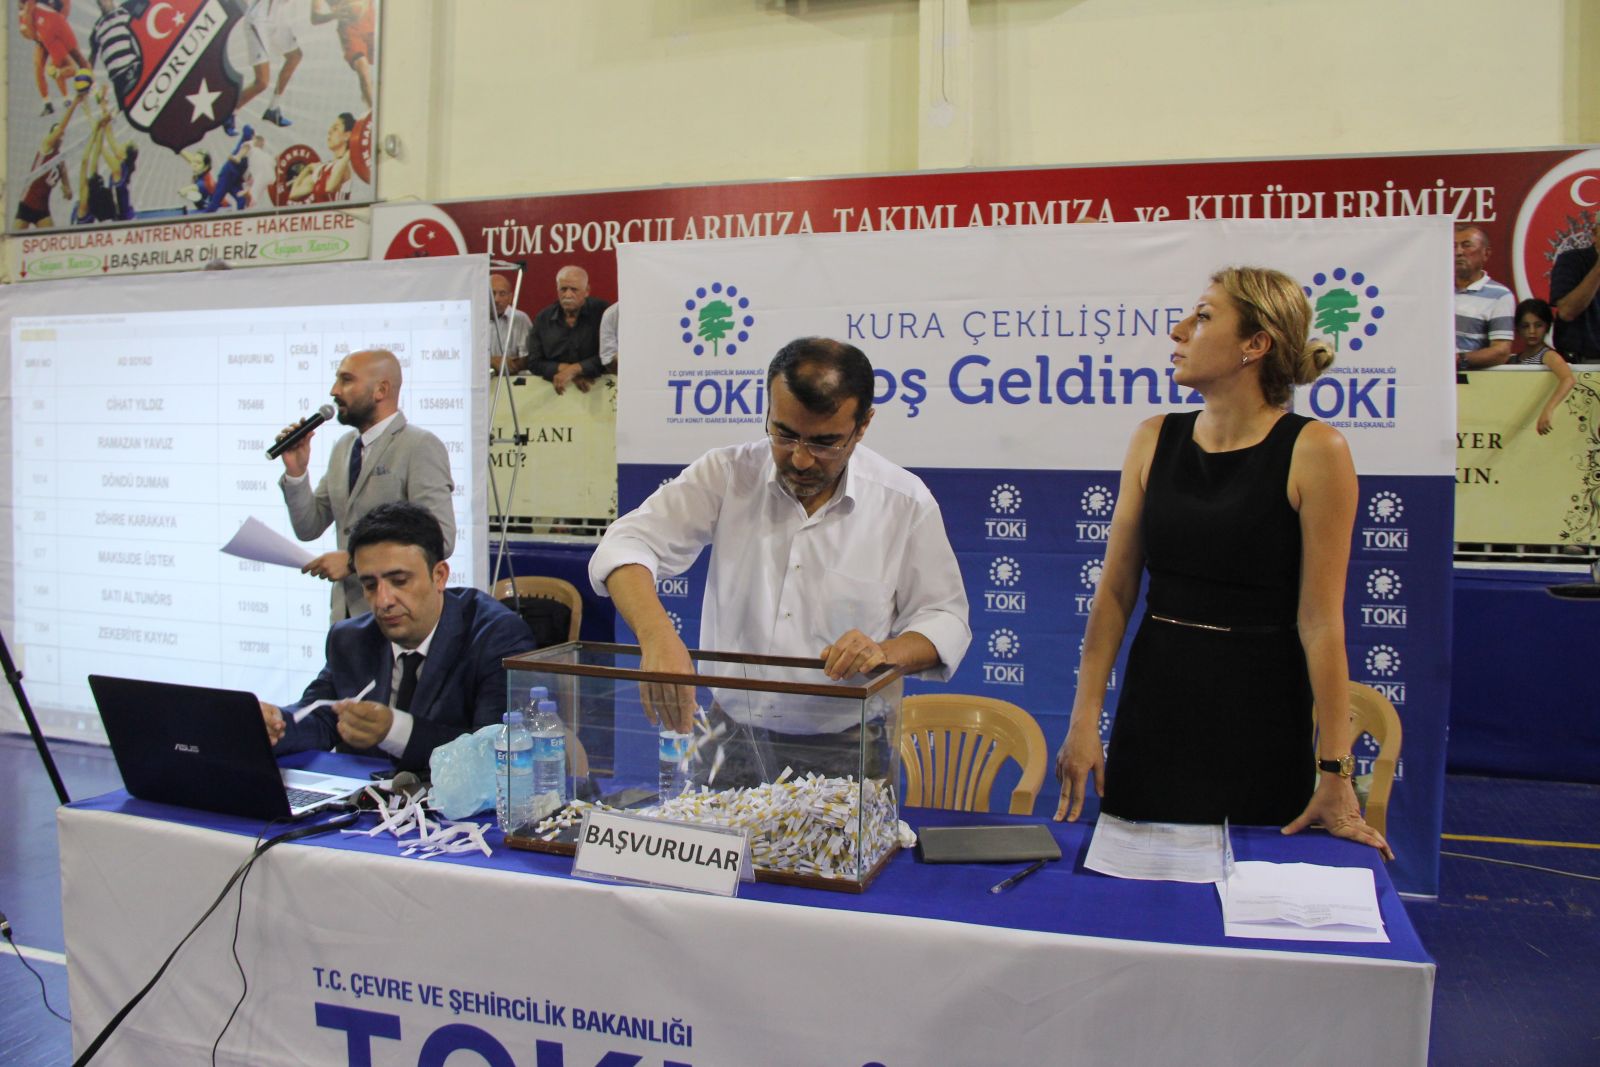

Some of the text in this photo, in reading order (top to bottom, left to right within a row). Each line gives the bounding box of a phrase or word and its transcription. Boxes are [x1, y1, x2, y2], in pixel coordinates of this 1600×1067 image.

[142, 11, 216, 112] ÇORUM
[22, 213, 354, 254] SPORCULARA ANTRENÖRLERE HAKEMLERE
[482, 219, 543, 256] TÜM
[1134, 204, 1170, 222] ve
[111, 249, 194, 269] BAŞARILAR
[199, 241, 258, 262] DİLERİZ
[846, 304, 1184, 345] KURA ÇEKİLİŞİNE
[872, 368, 927, 418] oş
[1456, 467, 1499, 484] IN.
[585, 824, 739, 872] BAŞVURULAR
[312, 966, 347, 992] T.C.
[350, 973, 413, 1002] ÇEVRE
[417, 983, 444, 1008] VE
[449, 991, 566, 1028] ŞEHİRCİLİK
[572, 1011, 692, 1047] BAKANLIĞI
